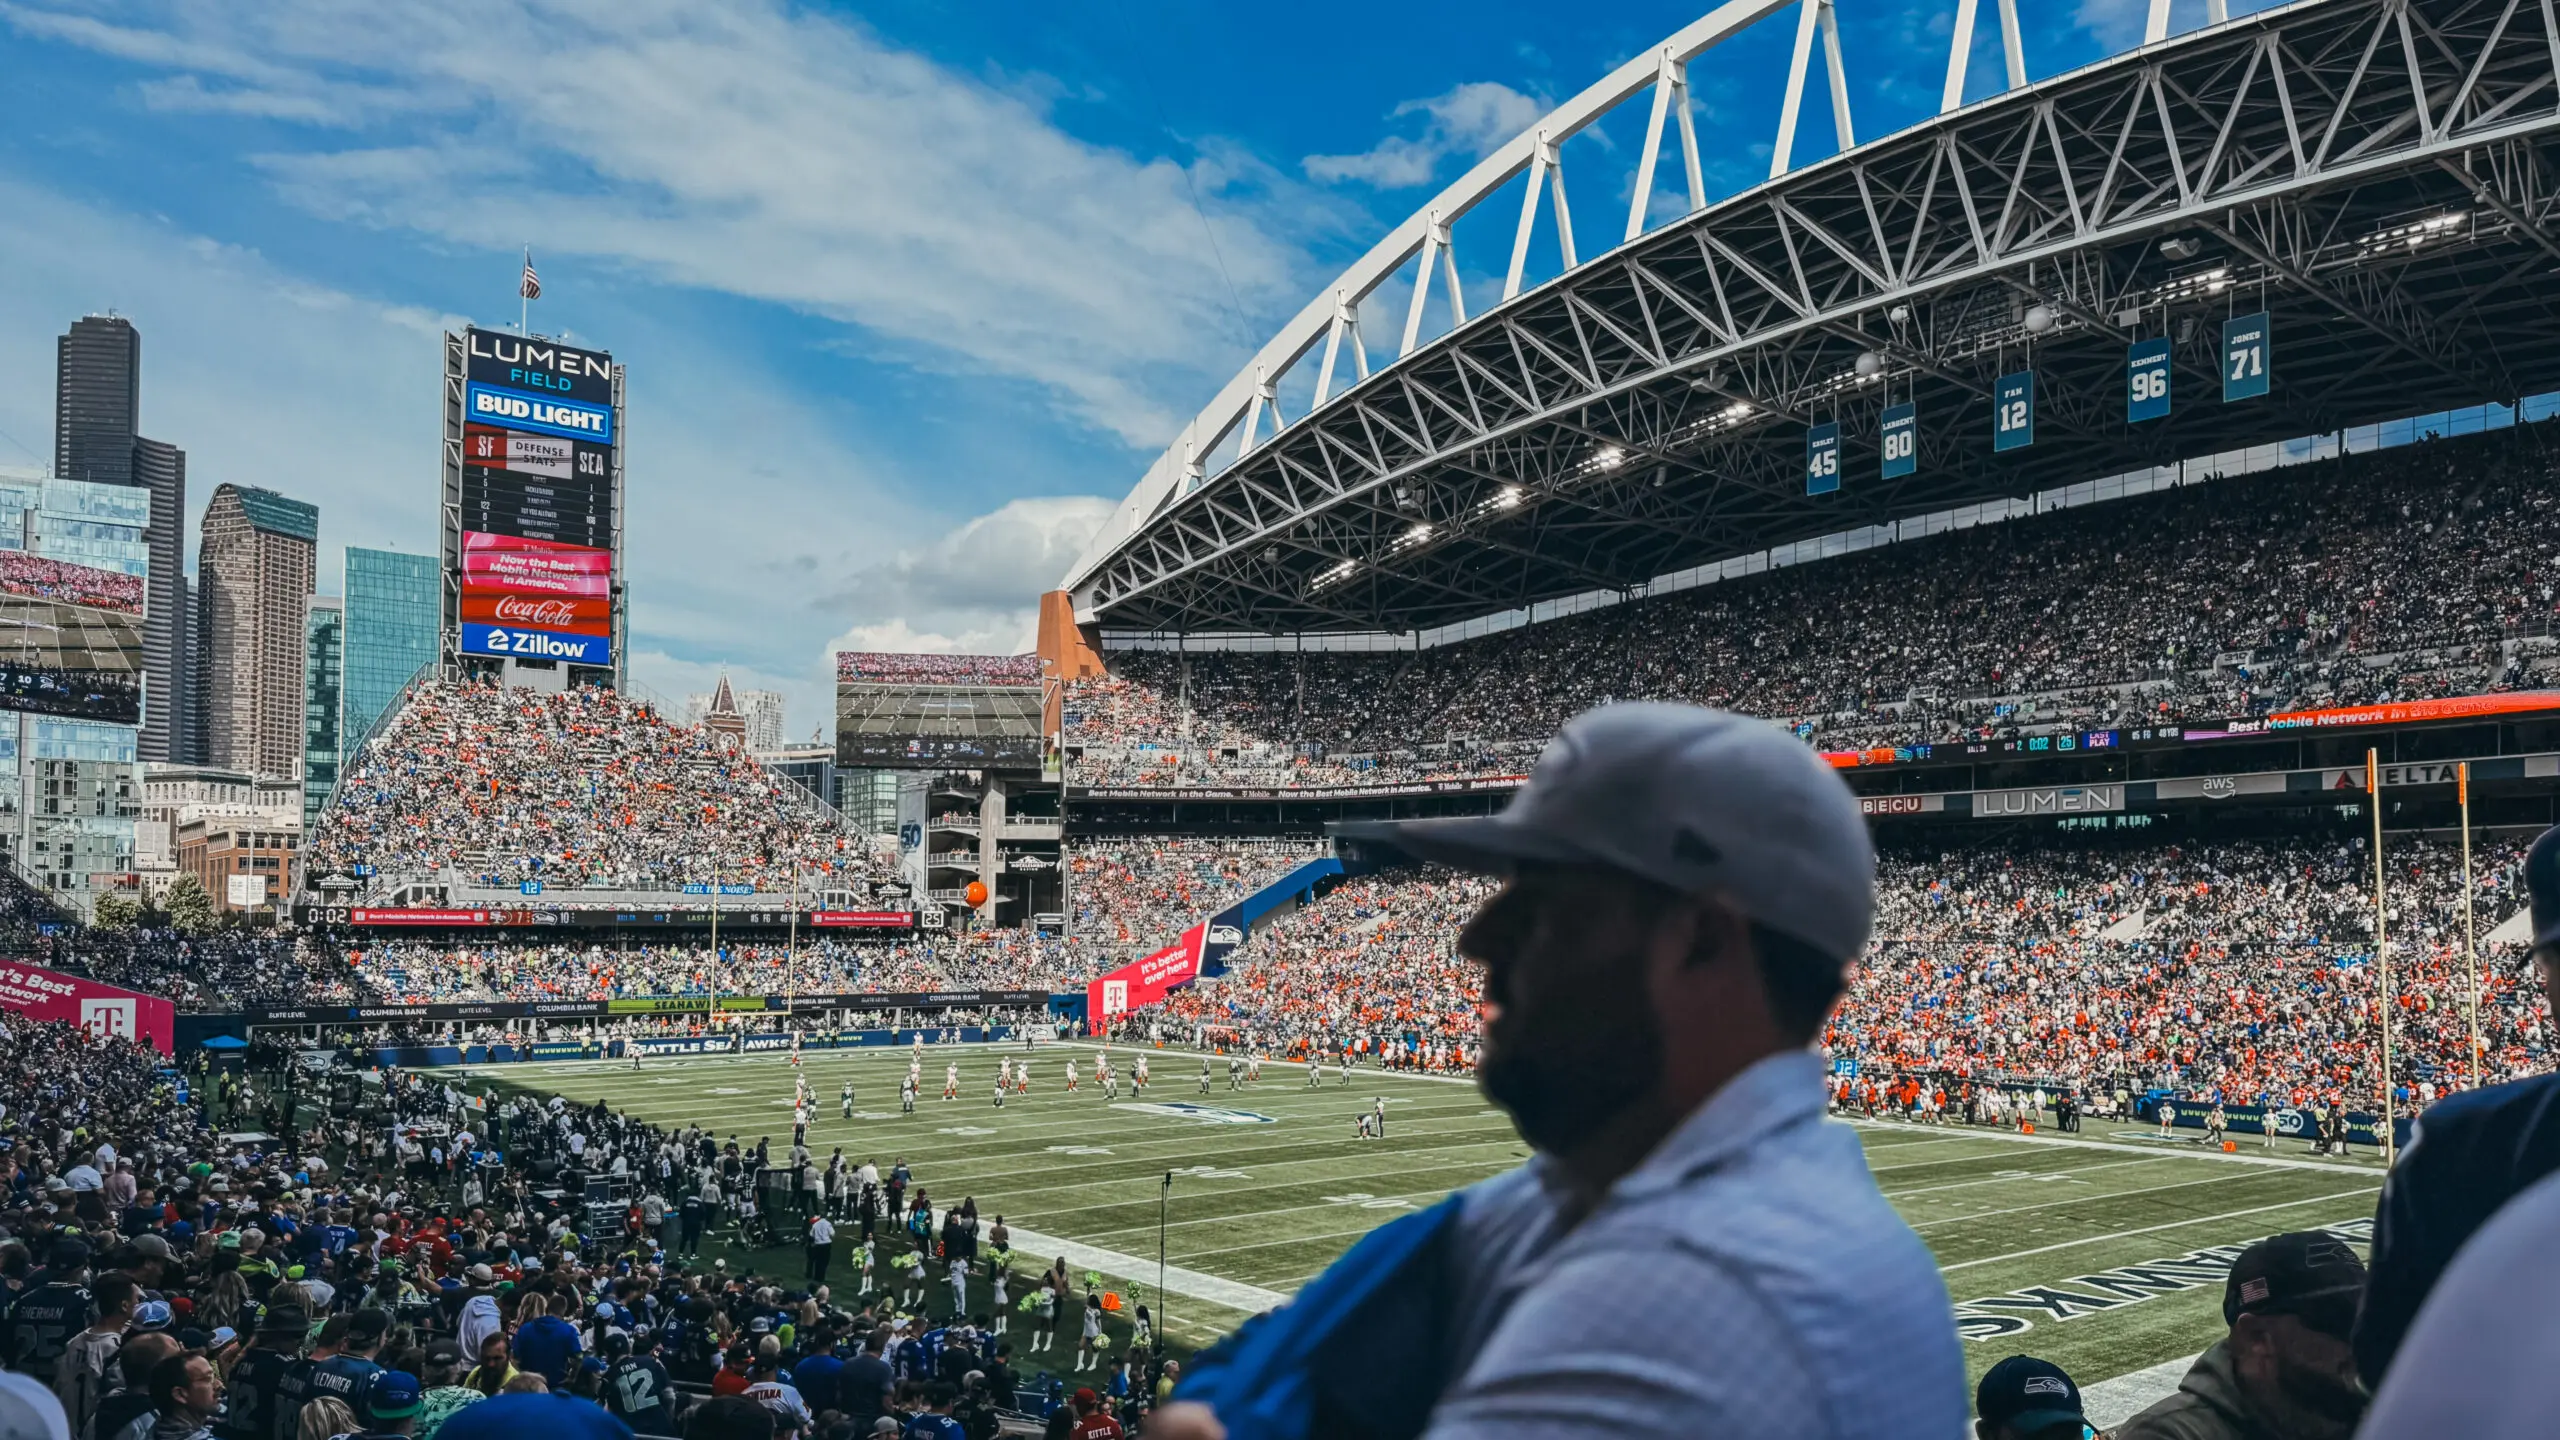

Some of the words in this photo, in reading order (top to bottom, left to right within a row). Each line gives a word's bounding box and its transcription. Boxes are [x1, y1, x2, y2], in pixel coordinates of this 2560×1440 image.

[2231, 330, 2260, 345] JONES
[470, 334, 610, 381] LUMEN
[2131, 353, 2167, 368] KENNEDY
[2230, 346, 2262, 380] 71
[510, 368, 572, 391] FIELD
[2132, 368, 2167, 402] 96
[2004, 387, 2023, 399] FAN
[477, 393, 530, 419] BUD
[533, 403, 604, 431] LIGHT
[2000, 400, 2027, 432] 12
[1882, 414, 1914, 431] LARGENT
[478, 435, 494, 457] SF
[516, 441, 565, 457] DEFENSE
[1812, 437, 1834, 448] EASLEY
[1884, 430, 1913, 461] 80
[523, 454, 556, 467] STATS
[579, 451, 604, 476] SEA
[1809, 449, 1837, 478] 45
[500, 554, 527, 565] Now
[529, 558, 548, 568] the
[550, 560, 575, 571] Best
[489, 563, 529, 575] Mobile
[531, 568, 580, 582] Network
[502, 575, 515, 584] in
[515, 576, 568, 590] America.
[495, 595, 577, 626] Coca-Cola
[512, 632, 585, 658] Zillow
[2228, 721, 2260, 733] Best
[2262, 716, 2314, 731] Mobile
[2316, 708, 2384, 727] Network
[2390, 708, 2406, 719] in
[2060, 736, 2072, 748] 25
[2089, 731, 2110, 739] LAST
[2089, 738, 2110, 747] PLAY
[2017, 741, 2022, 751] 2
[2029, 737, 2049, 750] 0:02
[2366, 765, 2455, 786] ELTA
[1278, 790, 1298, 798] Now
[1299, 789, 1314, 798] the
[1315, 789, 1333, 797] Best
[1333, 788, 1358, 797] Mobile
[1359, 787, 1390, 796] Network
[1390, 786, 1398, 794] in
[1399, 784, 1432, 793] America.
[1470, 780, 1488, 789] Best
[1489, 779, 1514, 788] Mobile
[2203, 777, 2235, 790] aws
[1088, 790, 1108, 798] Best
[1109, 790, 1139, 798] Mobile
[1140, 790, 1177, 798] Network
[1179, 790, 1188, 798] in
[1189, 790, 1204, 798] the
[1205, 790, 1234, 798] Game.
[1983, 787, 2112, 815] LUMEN
[901, 824, 921, 847] 50
[360, 864, 373, 874] 12
[526, 884, 537, 894] 12
[682, 885, 704, 894] FEEL
[308, 908, 347, 923] 0:02
[517, 912, 522, 923] 7
[560, 912, 569, 923] 10
[665, 913, 671, 923] 2
[925, 914, 940, 925] 25
[1141, 960, 1157, 975] It's
[1158, 948, 1188, 967] better
[1144, 970, 1166, 986] over
[1166, 959, 1189, 975] here
[25, 974, 76, 997] Best
[360, 1009, 403, 1017] COLUMBIA
[404, 1008, 427, 1016] BANK
[536, 1004, 576, 1012] COLUMBIA
[577, 1003, 598, 1011] BANK
[654, 1000, 722, 1011] SEAHAWS
[703, 1039, 791, 1051] SEAAWKS
[1840, 1061, 1853, 1075] 12
[1102, 1293, 1111, 1308] 10
[668, 1321, 677, 1330] 16
[620, 1362, 638, 1373] FAN
[616, 1367, 660, 1413] 12
[1088, 1426, 1112, 1440] KITTLE
